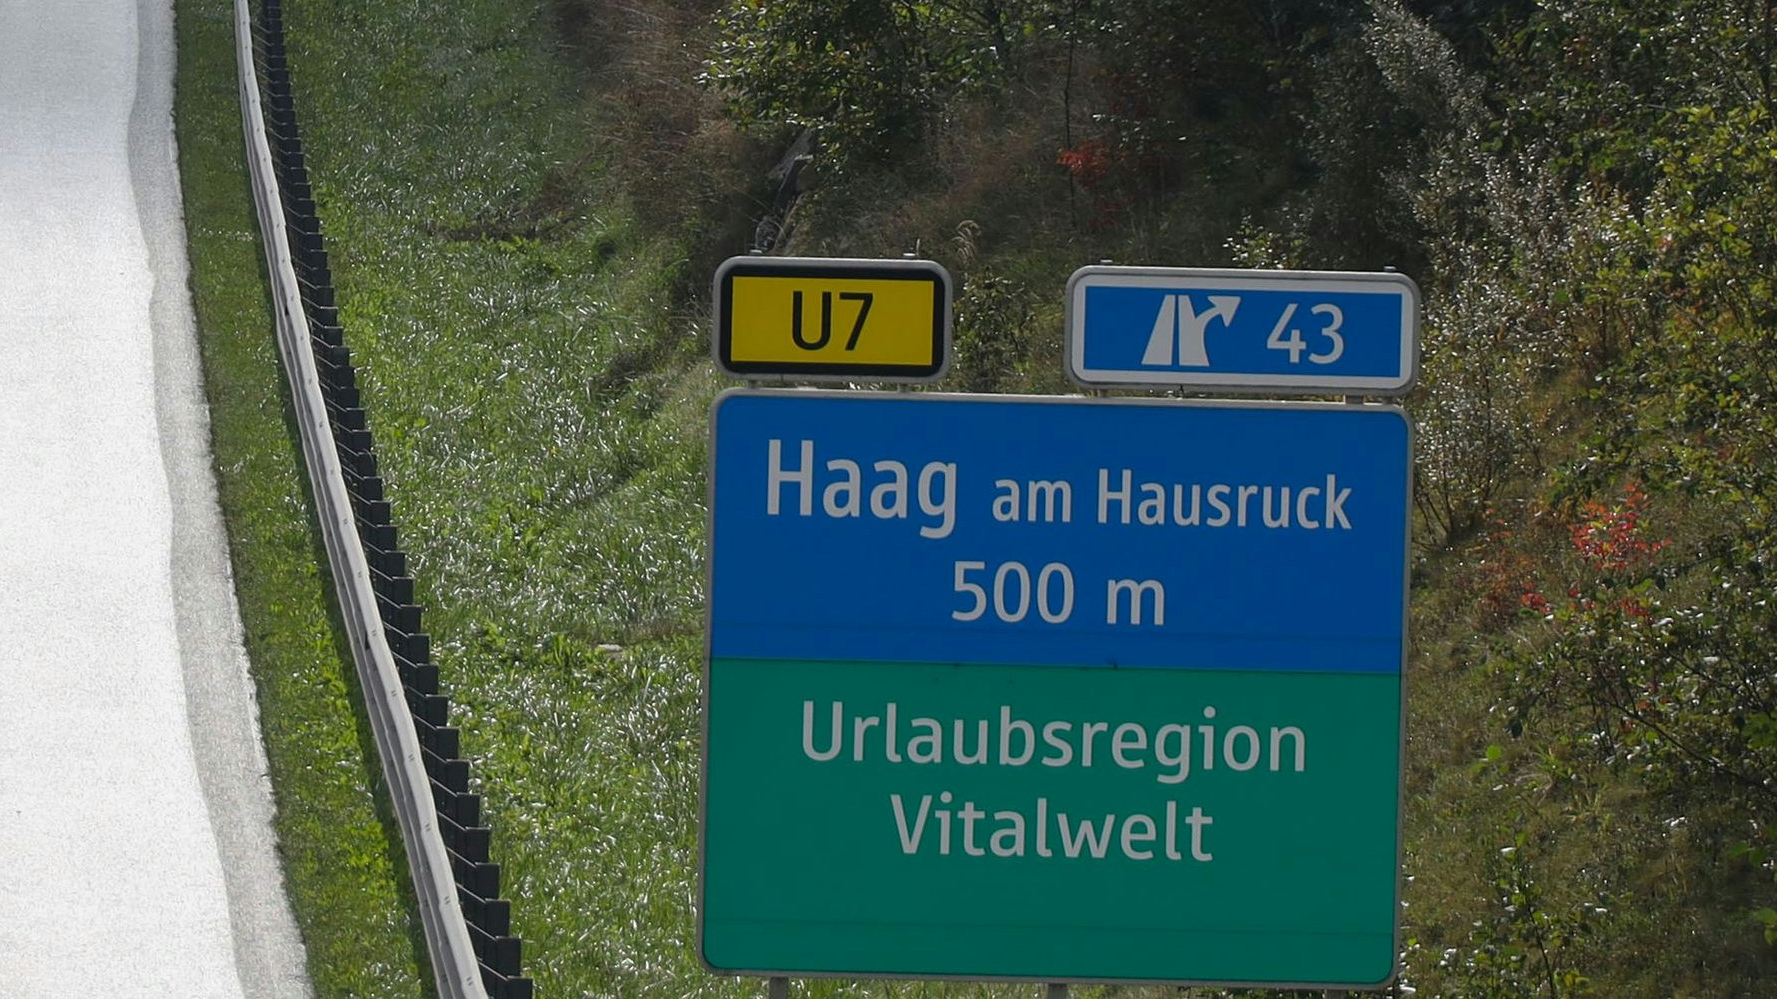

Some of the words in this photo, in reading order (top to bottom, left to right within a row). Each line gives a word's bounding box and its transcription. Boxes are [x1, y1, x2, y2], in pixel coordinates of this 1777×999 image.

[791, 290, 874, 351] U7
[1266, 303, 1345, 364] 43
[766, 439, 957, 539] Haag
[992, 474, 1072, 523] am
[1097, 468, 1352, 530] Hausruck
[951, 561, 1074, 624] 500
[1106, 576, 1165, 626] m
[801, 700, 1305, 784] Urlaubsregion
[890, 791, 1214, 862] Vitalwelt
